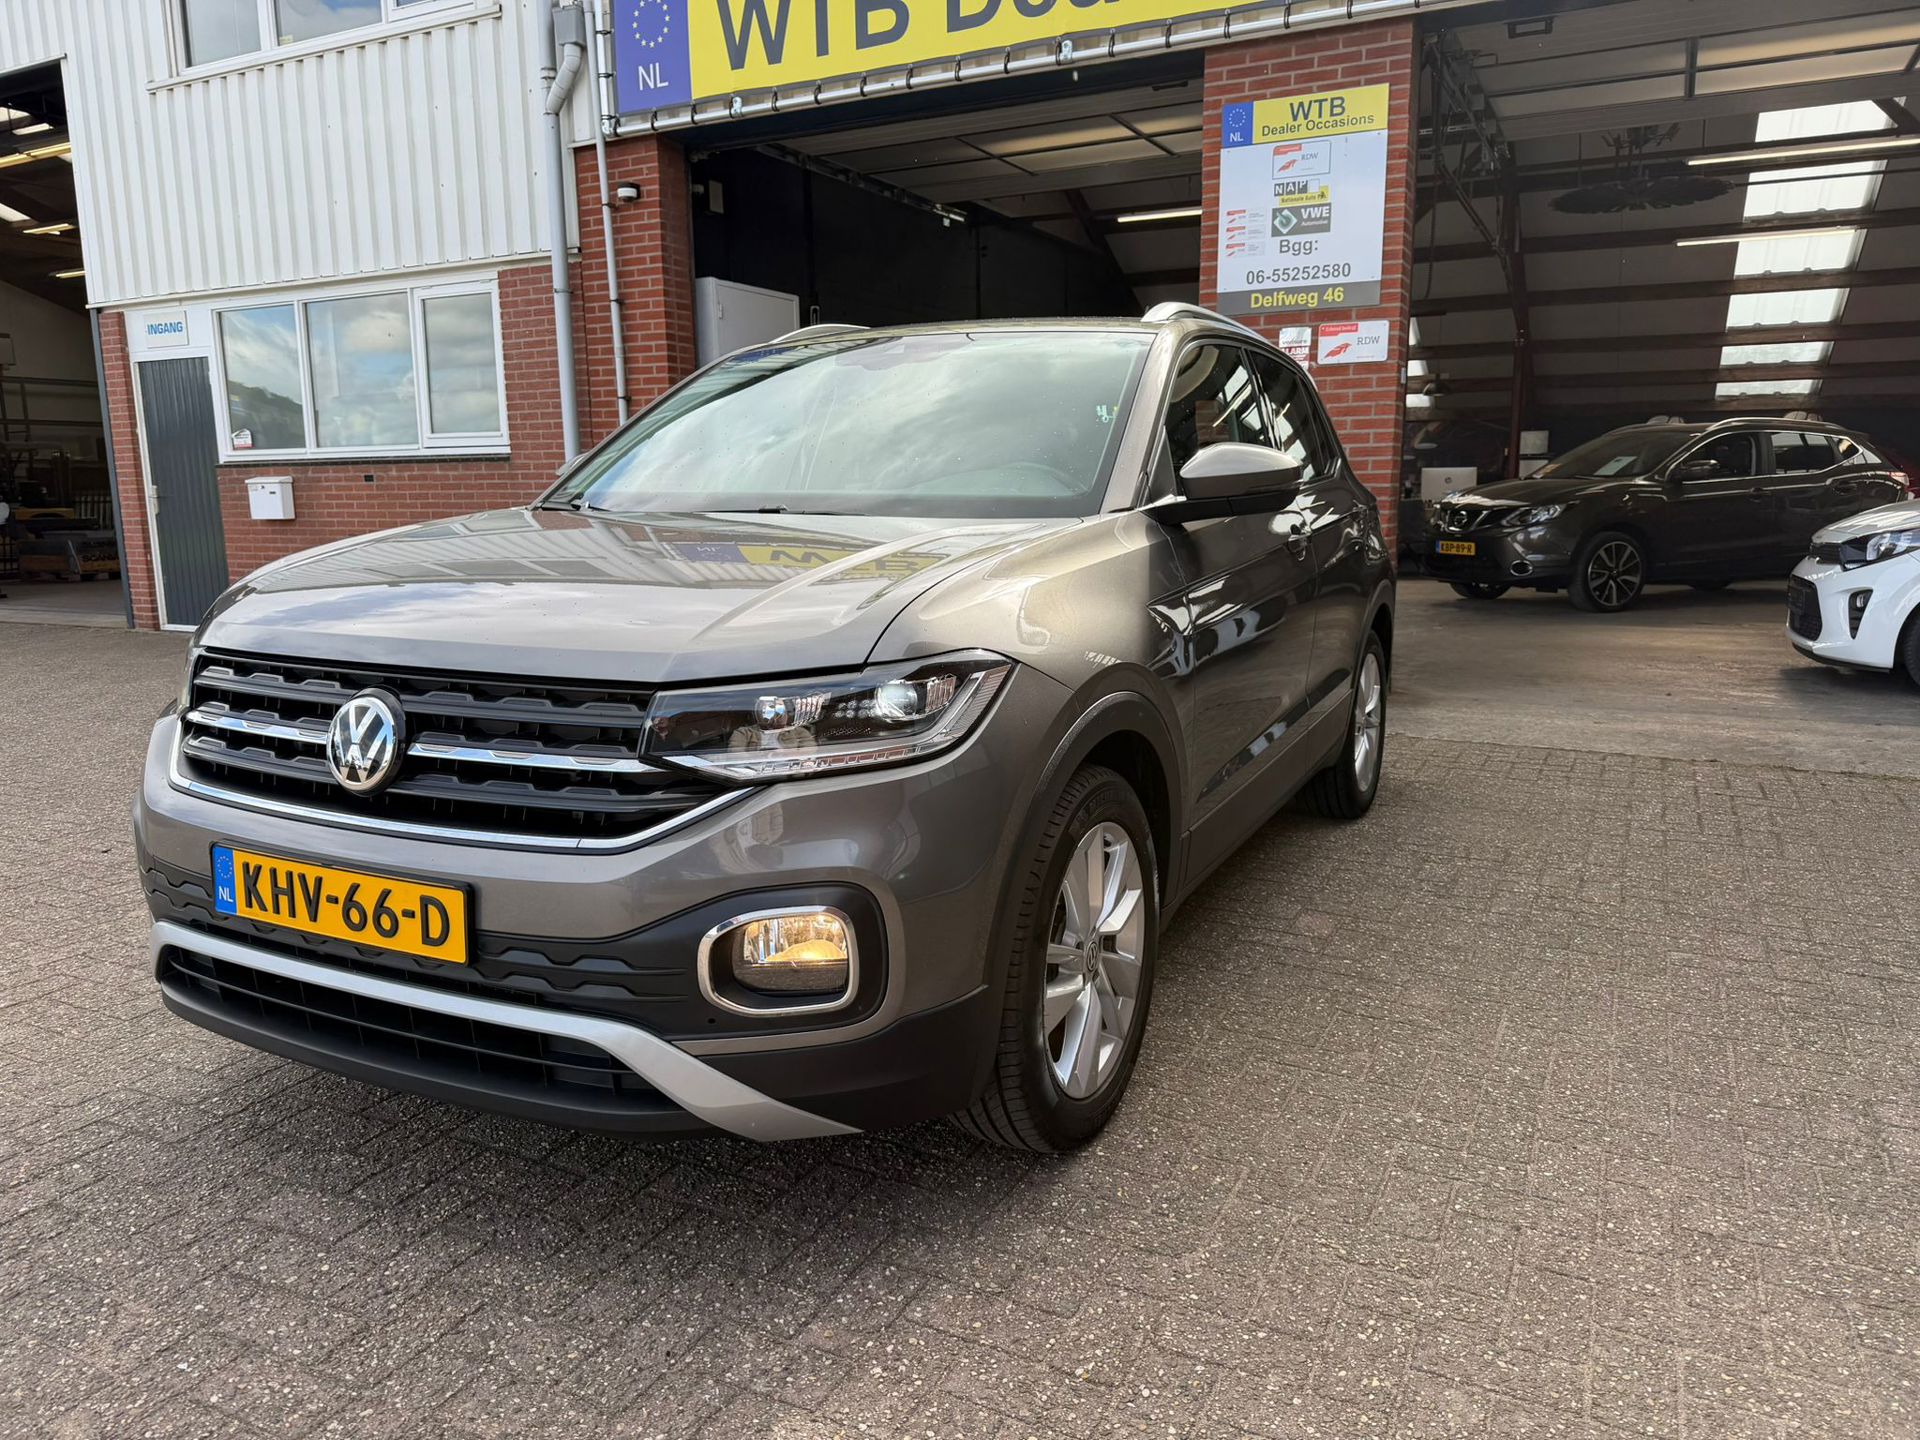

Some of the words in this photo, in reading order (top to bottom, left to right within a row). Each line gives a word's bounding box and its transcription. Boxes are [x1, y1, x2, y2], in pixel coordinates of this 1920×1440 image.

[637, 63, 669, 91] NL
[1289, 96, 1346, 122] WTB
[1261, 121, 1302, 137] Dealer
[1305, 114, 1374, 132] Occasions
[1229, 132, 1244, 142] NL
[1301, 152, 1319, 161] RDW
[1301, 206, 1330, 219] VWE
[1279, 239, 1319, 256] Bgg:
[1246, 263, 1351, 285] 06-55252580
[1251, 290, 1318, 308] Delfweg
[1323, 287, 1344, 302] 46
[147, 321, 183, 335] INGANG
[1356, 336, 1380, 346] RDW
[218, 886, 234, 902] NL
[242, 861, 450, 947] KHV-66-D
